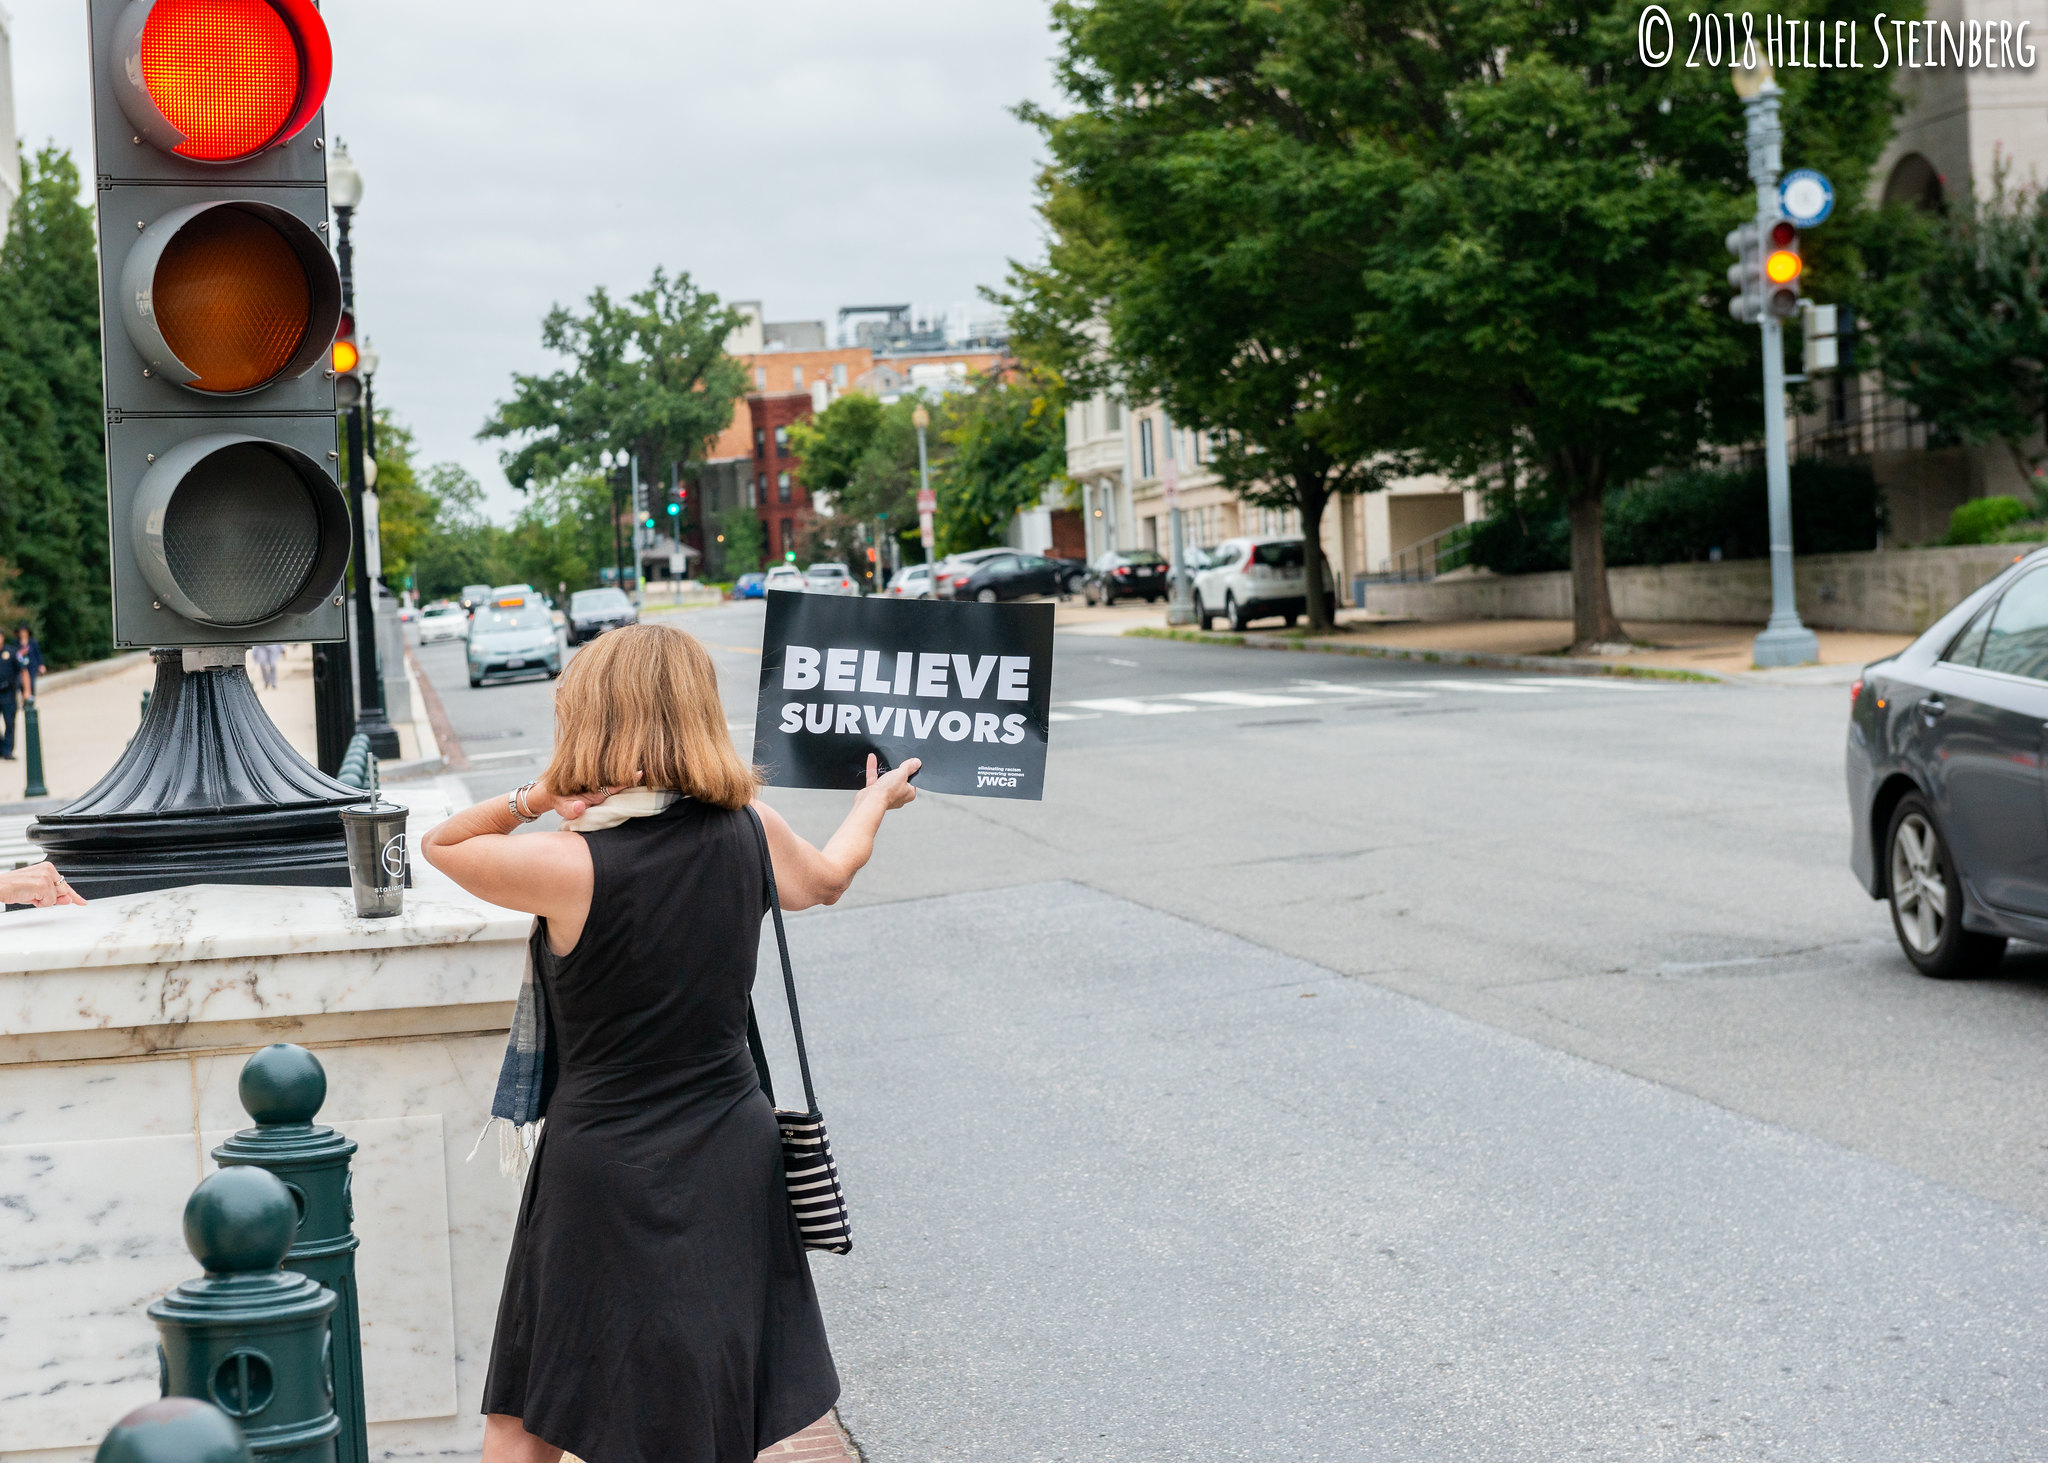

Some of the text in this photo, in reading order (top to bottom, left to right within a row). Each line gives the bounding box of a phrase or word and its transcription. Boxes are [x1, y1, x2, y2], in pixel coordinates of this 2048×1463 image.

[782, 645, 1030, 701] BELIEVE
[779, 702, 1027, 745] SURVIVORS
[976, 776, 1017, 788] ywca
